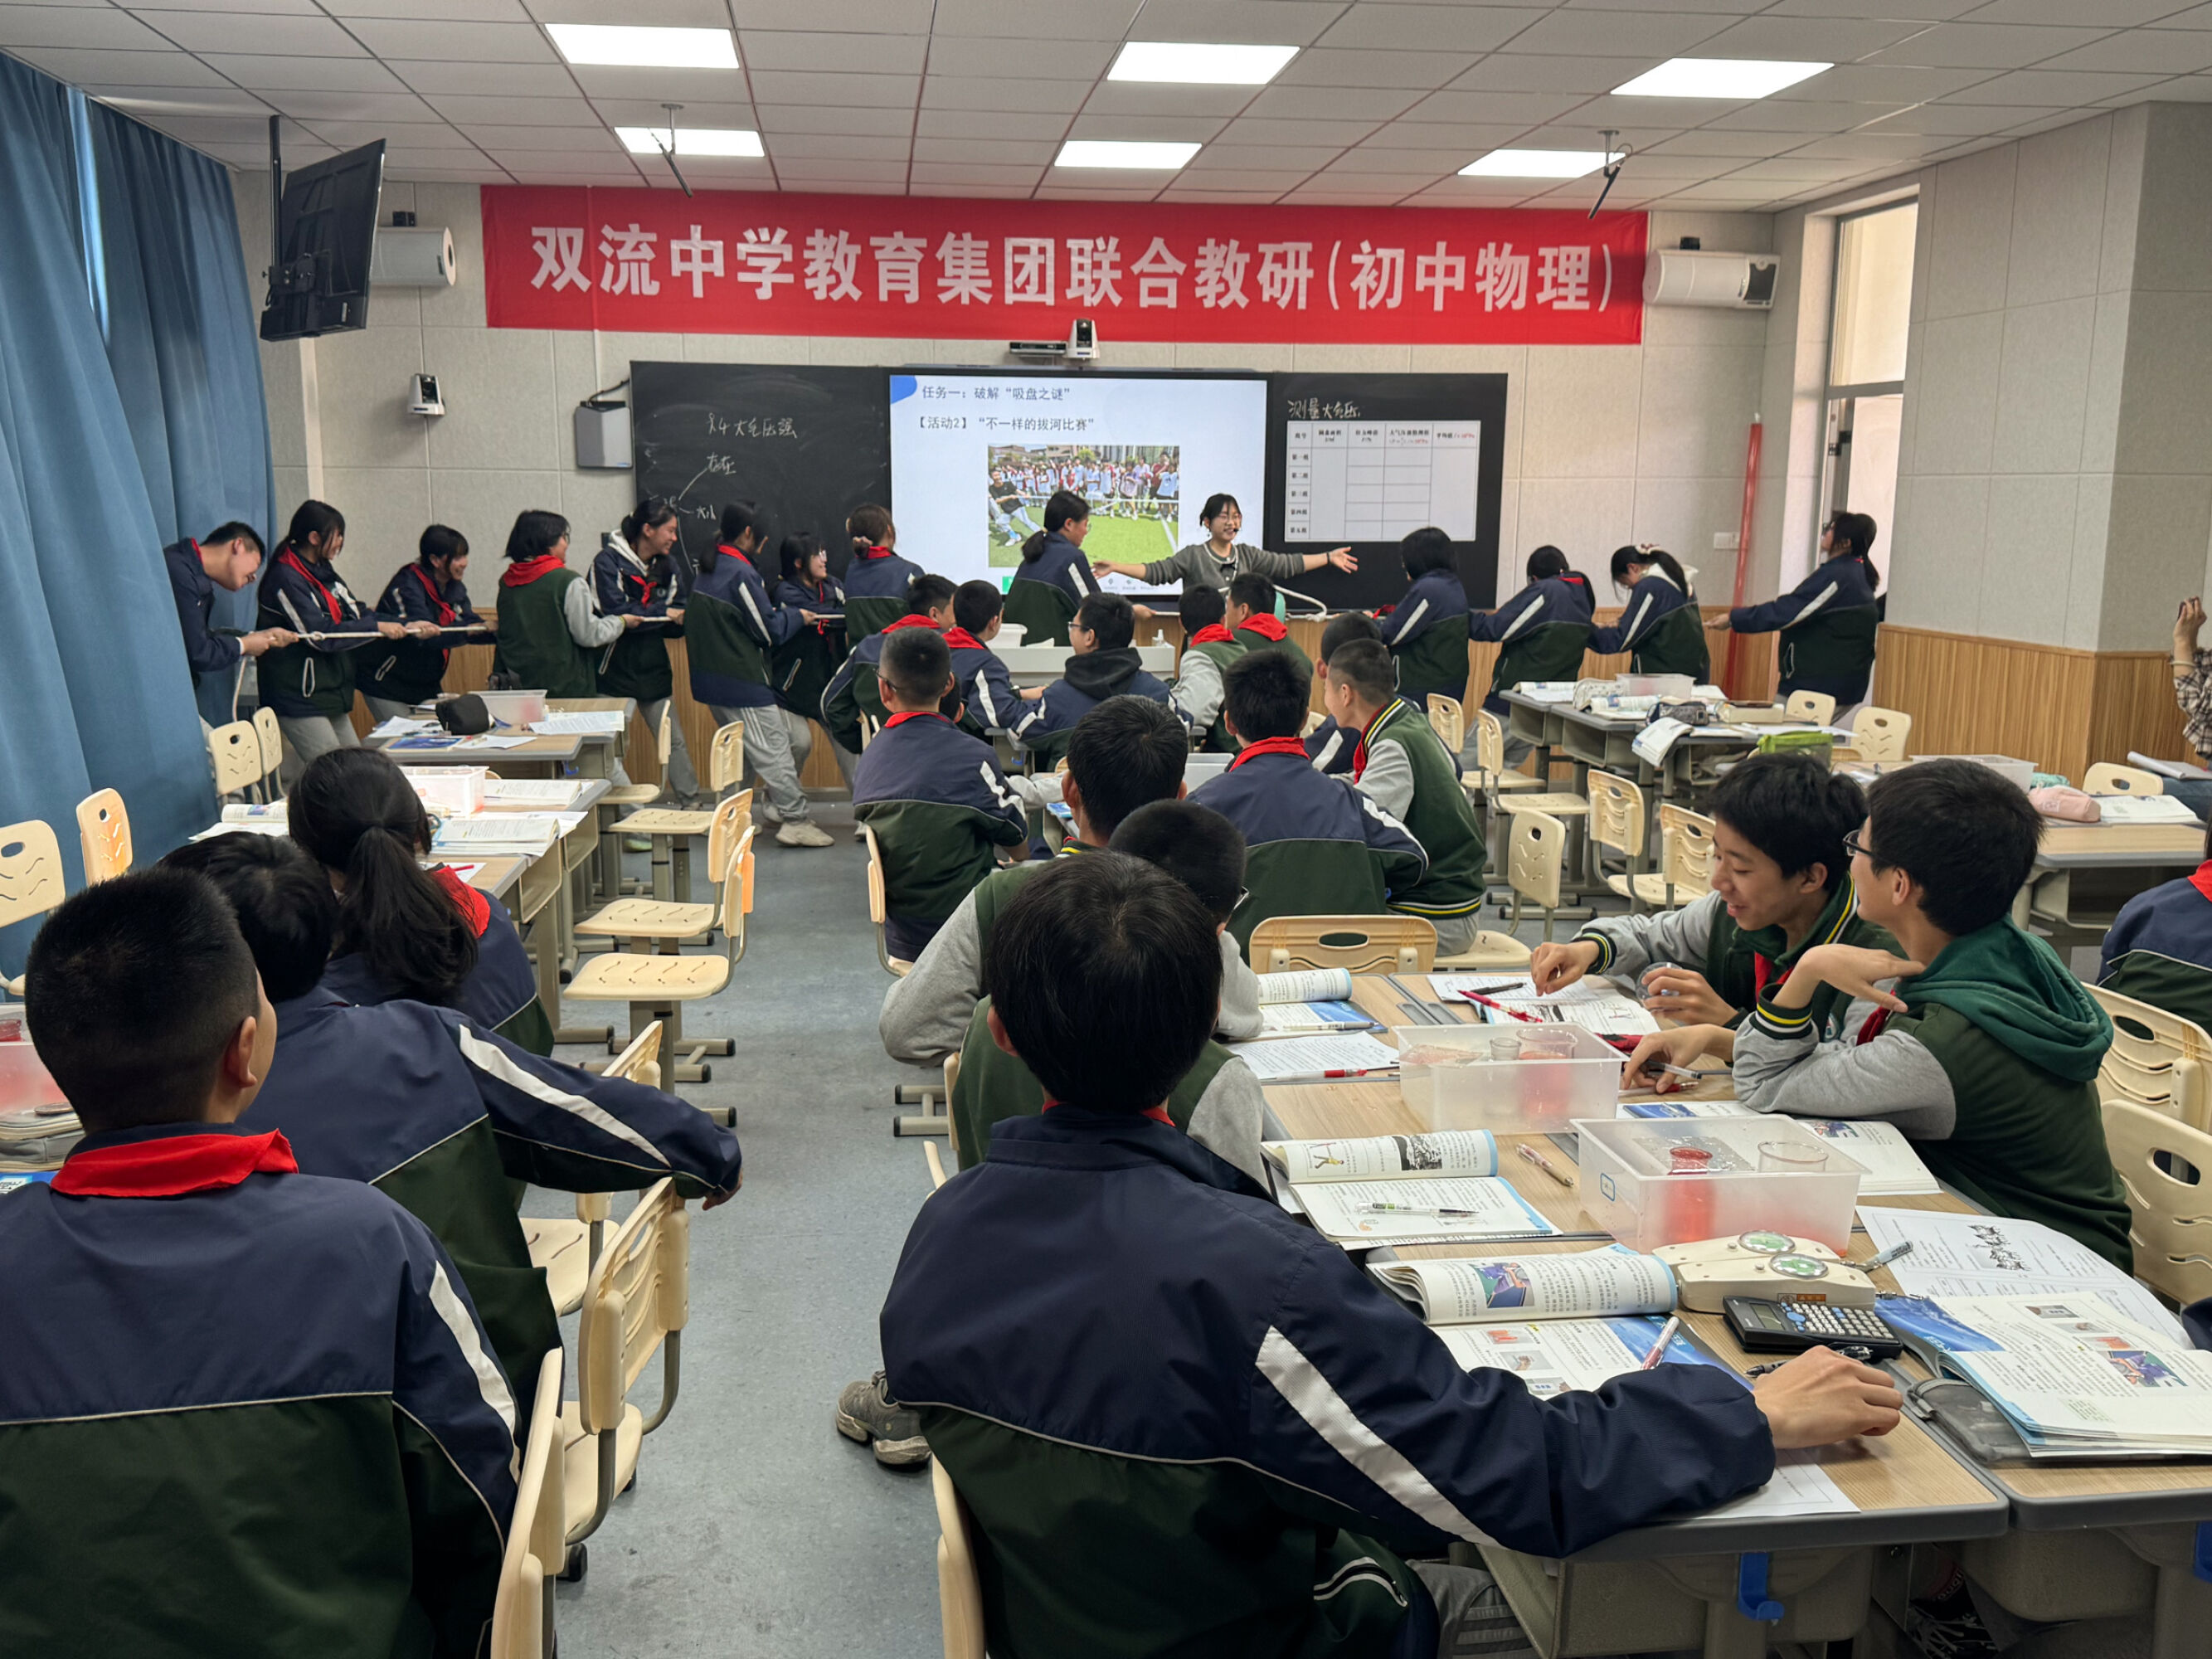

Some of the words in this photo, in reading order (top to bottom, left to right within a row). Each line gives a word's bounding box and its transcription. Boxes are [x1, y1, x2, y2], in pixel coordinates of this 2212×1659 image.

[530, 222, 1613, 313] 双流中学教育集团联合教研(初中物理)
